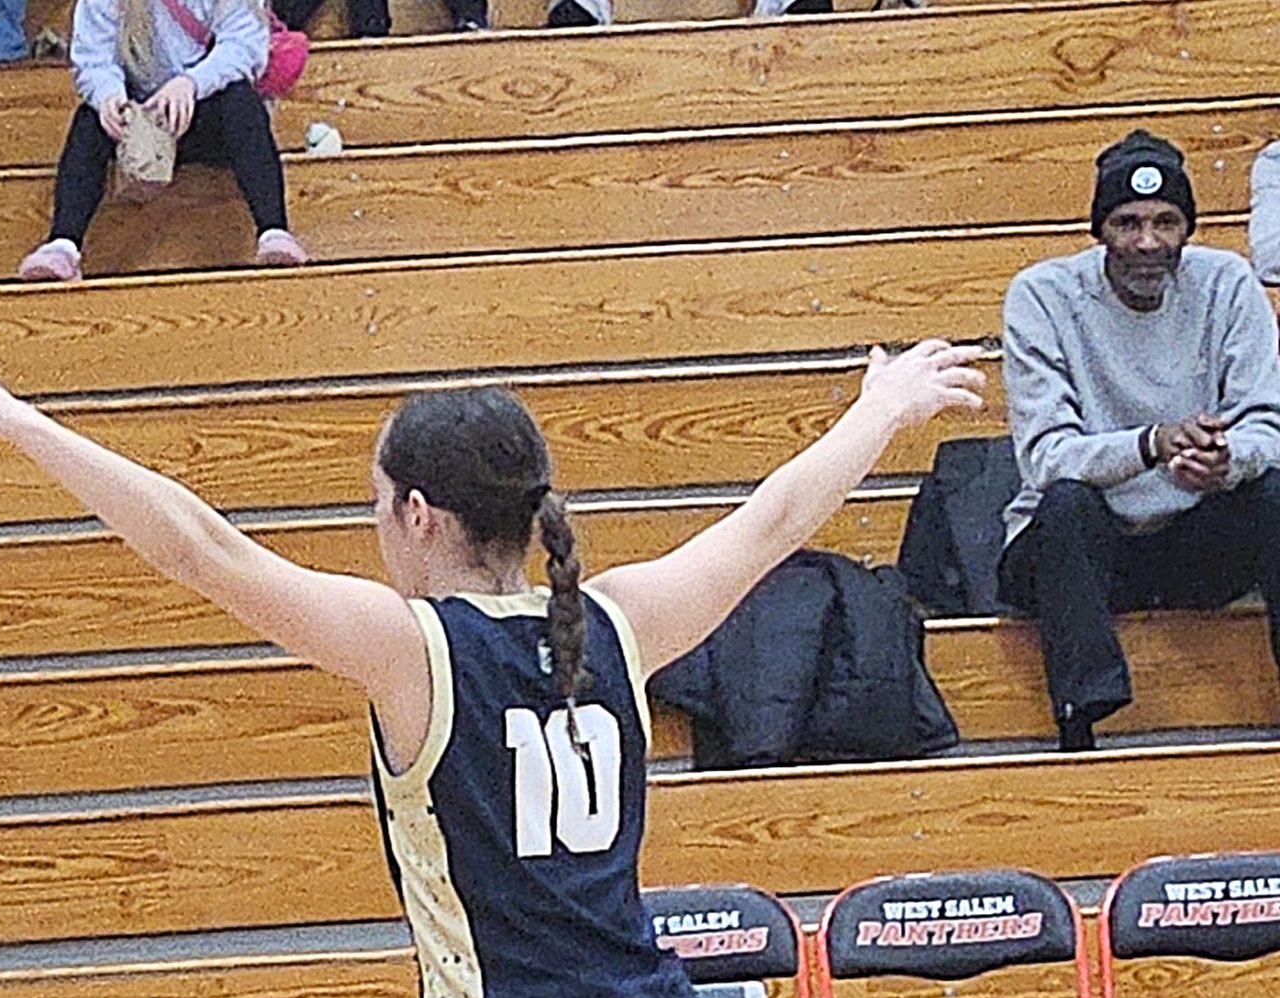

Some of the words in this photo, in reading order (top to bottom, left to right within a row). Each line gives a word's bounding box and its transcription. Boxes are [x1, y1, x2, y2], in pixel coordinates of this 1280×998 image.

[504, 704, 622, 858] 10
[1164, 881, 1227, 901] WEST
[883, 900, 942, 919] WEST
[944, 895, 1015, 918] SALEM
[856, 912, 1043, 946] PANTHERS
